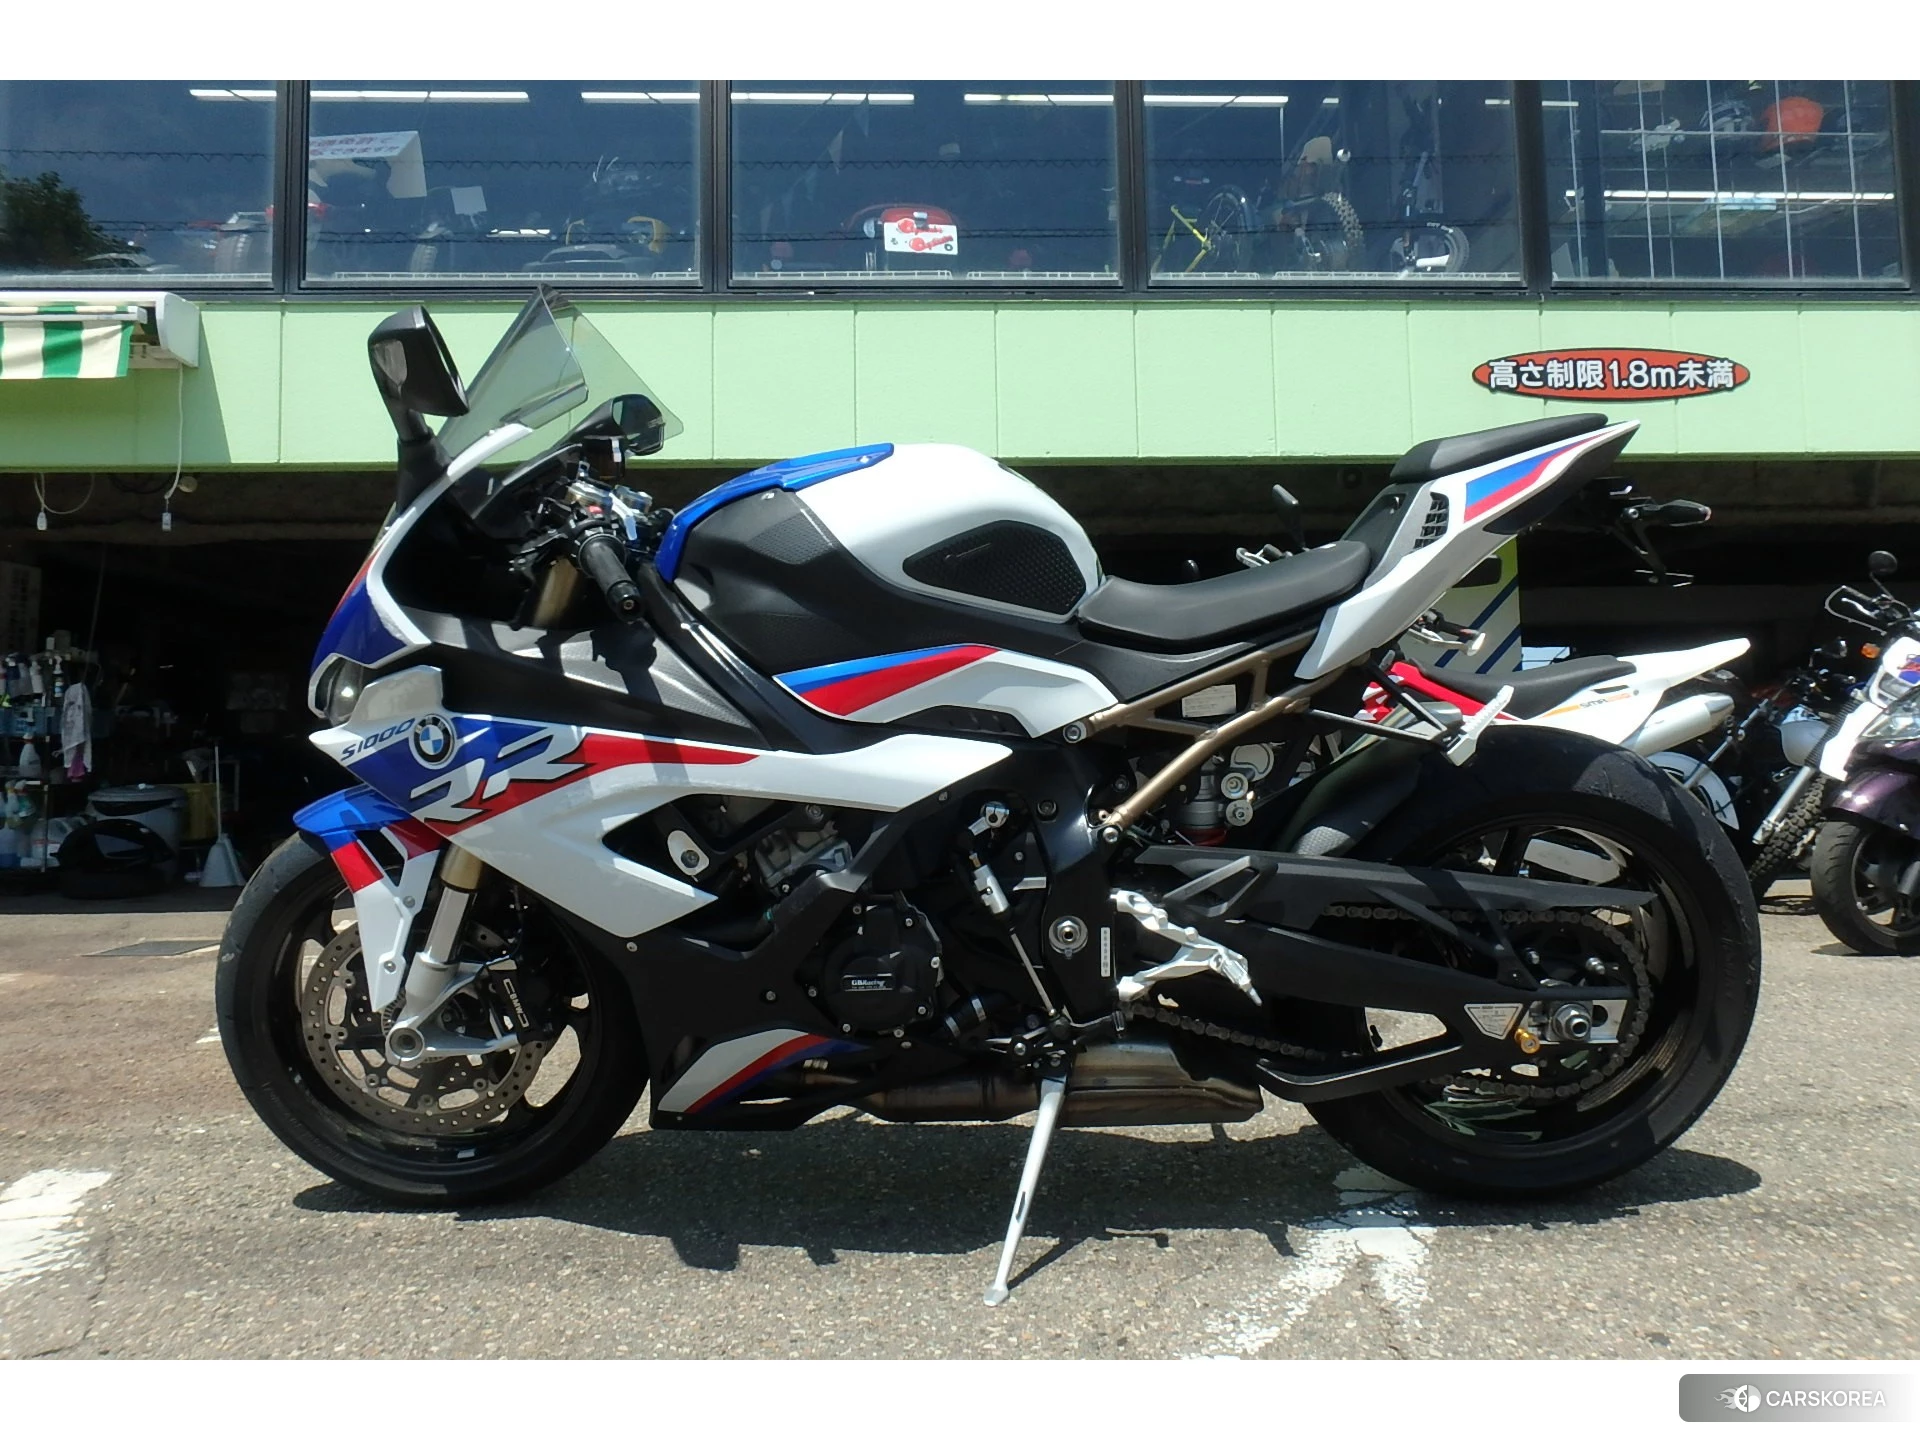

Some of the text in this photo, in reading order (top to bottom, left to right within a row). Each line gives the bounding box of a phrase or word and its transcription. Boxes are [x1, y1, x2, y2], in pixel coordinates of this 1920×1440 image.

[1488, 359, 1735, 389] 高さ制限1.8m未満
[340, 717, 416, 762] S1000
